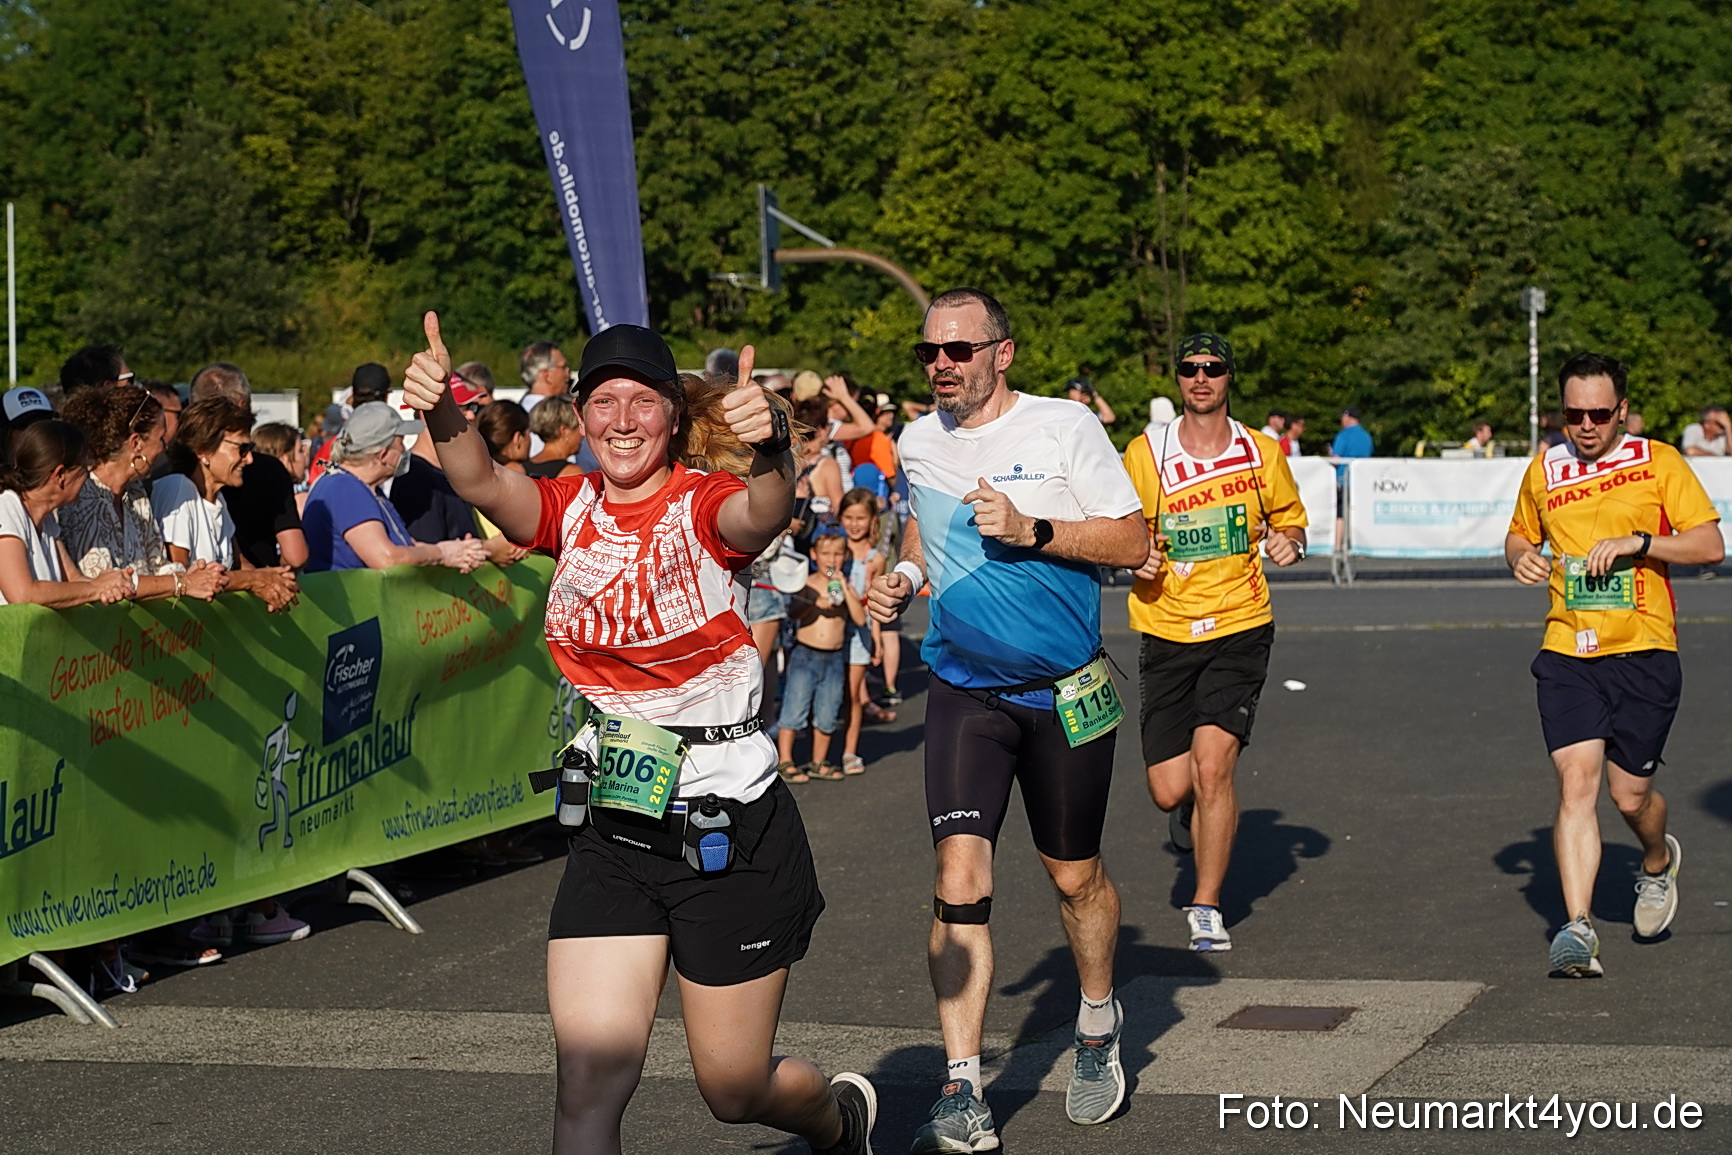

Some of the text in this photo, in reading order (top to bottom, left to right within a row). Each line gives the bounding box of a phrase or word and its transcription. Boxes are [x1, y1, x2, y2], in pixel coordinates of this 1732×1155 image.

[1168, 475, 1267, 514] MAX BÖGL
[1547, 469, 1655, 512] MAX BÖGL
[1177, 526, 1212, 546] 808
[51, 619, 204, 702] Gesunde Firmen
[333, 657, 375, 685] Fischer
[89, 686, 147, 748] laufen
[1064, 709, 1080, 734] RUN
[1082, 711, 1109, 730] Bankel
[297, 693, 421, 809] firmenlauf
[608, 781, 640, 795] Marina
[649, 766, 671, 805] 2022
[300, 793, 354, 837] neumarkt
[740, 939, 771, 951] benger
